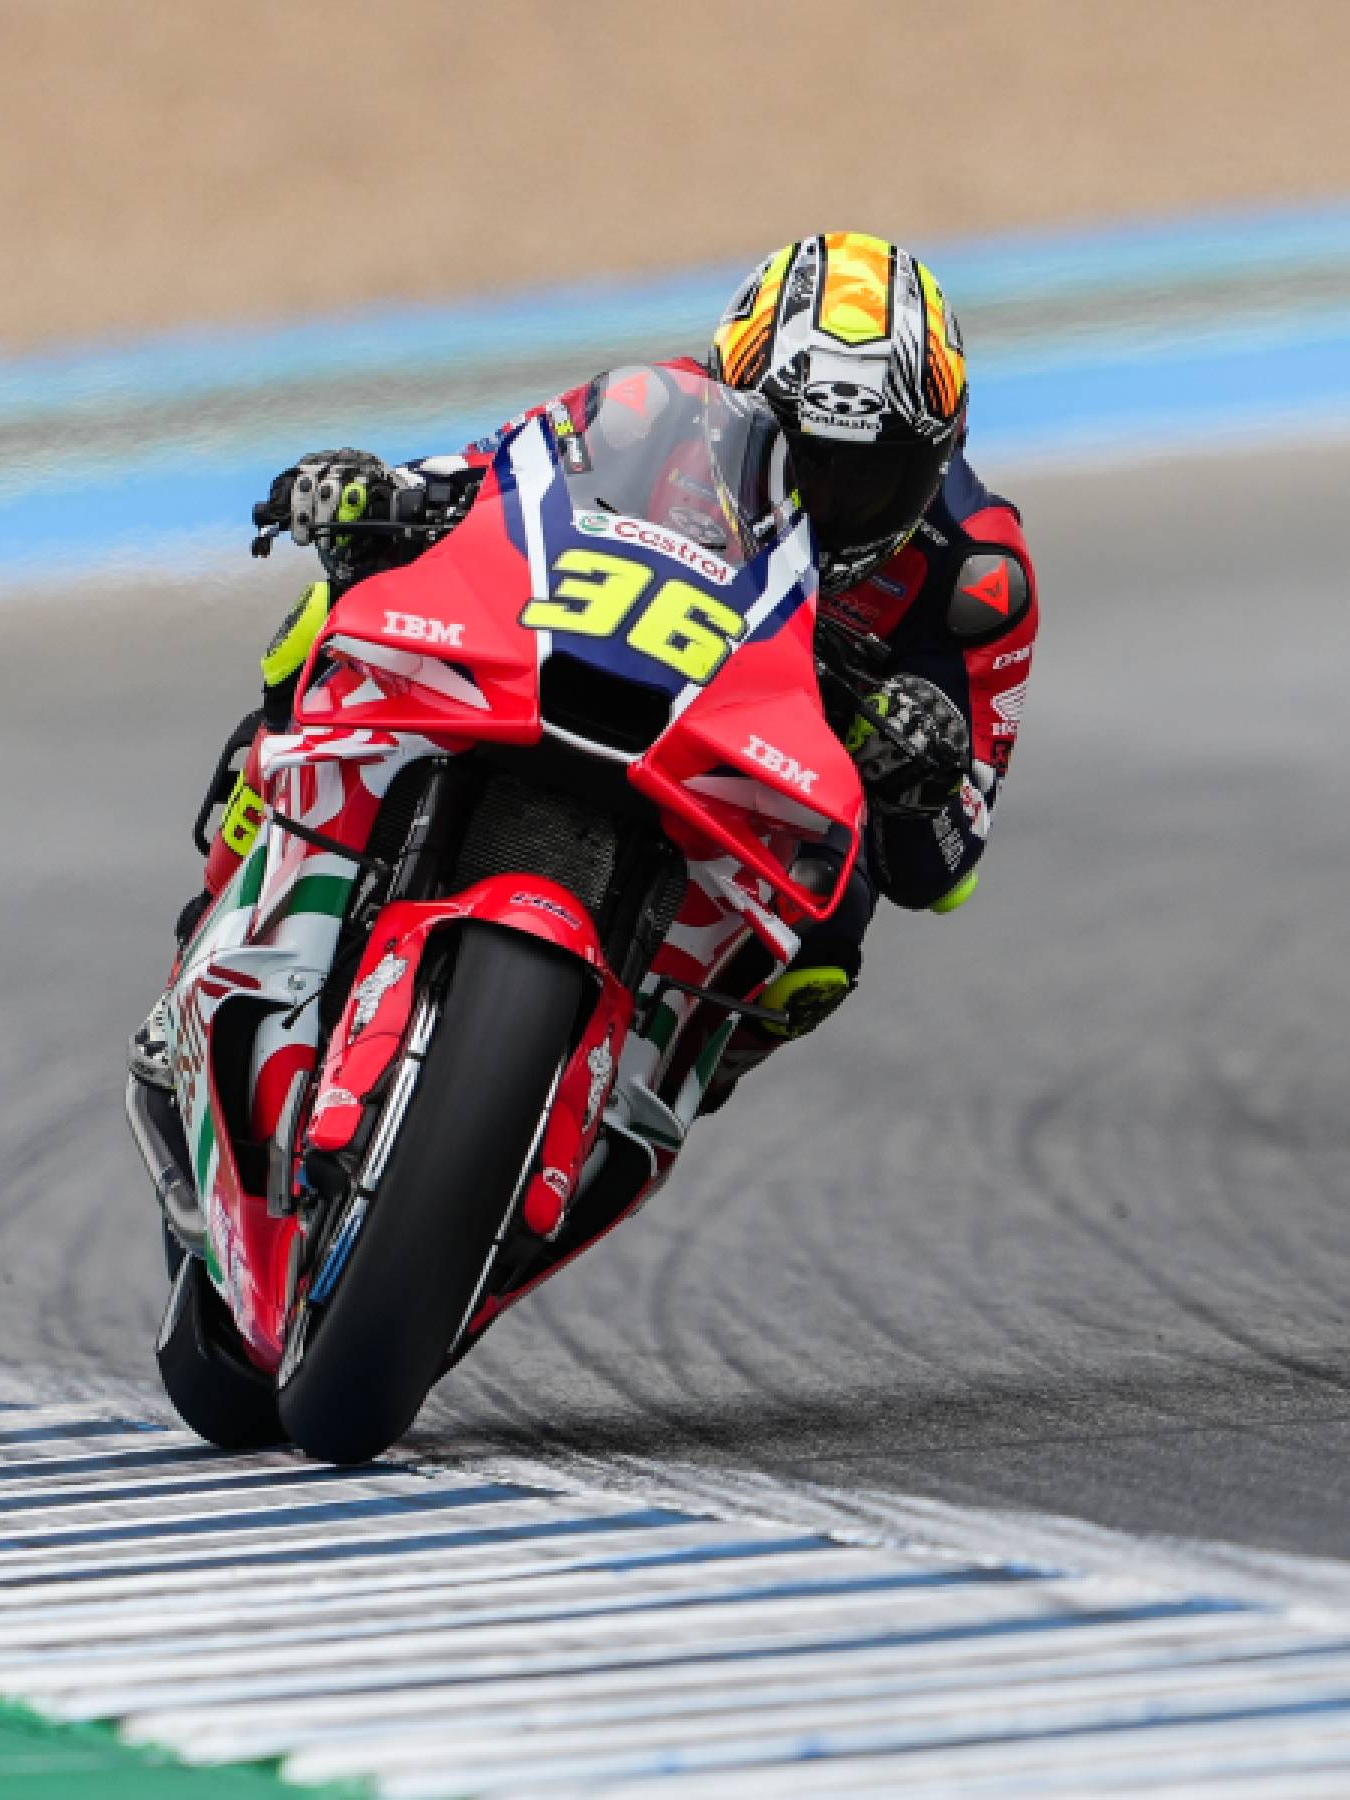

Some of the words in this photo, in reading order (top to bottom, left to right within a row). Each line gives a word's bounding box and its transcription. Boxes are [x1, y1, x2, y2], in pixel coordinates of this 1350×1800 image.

[615, 520, 728, 584] Castrol
[383, 611, 464, 647] IBM
[521, 549, 746, 685] 36
[742, 735, 818, 793] IBM
